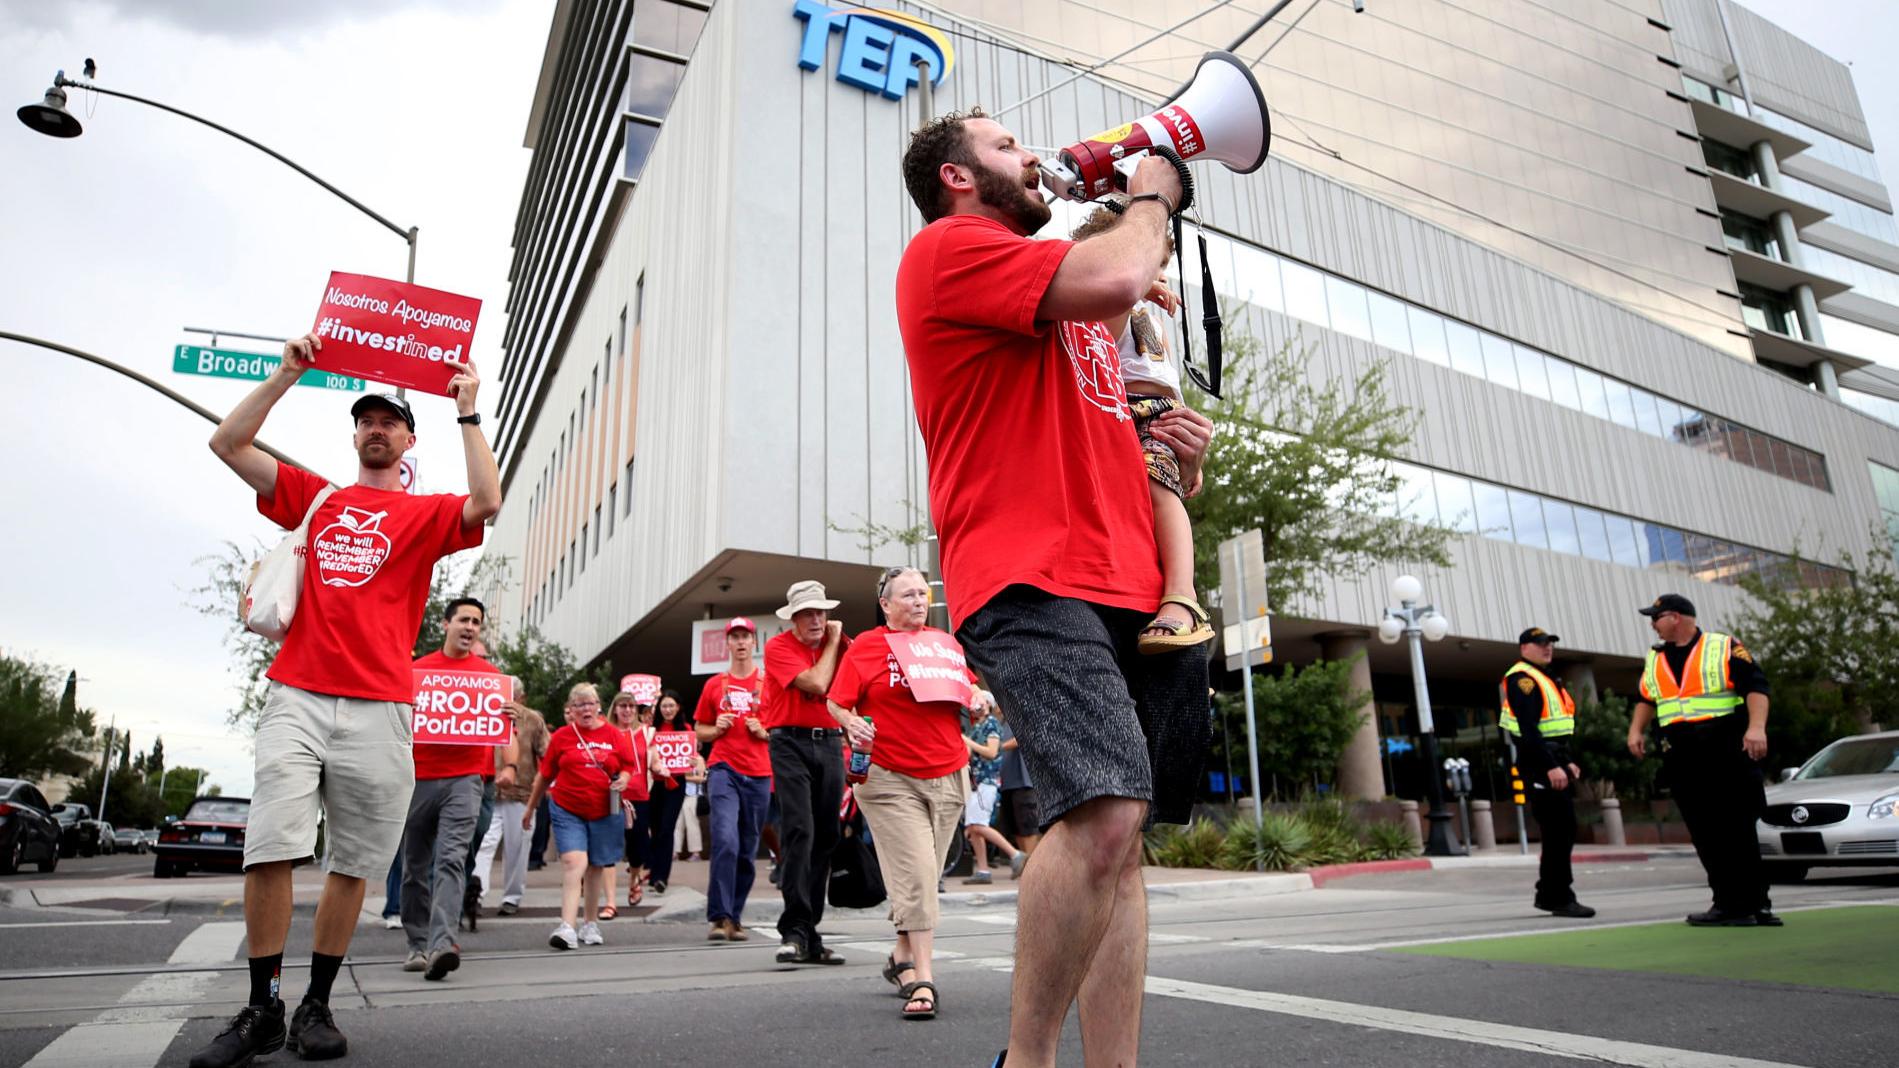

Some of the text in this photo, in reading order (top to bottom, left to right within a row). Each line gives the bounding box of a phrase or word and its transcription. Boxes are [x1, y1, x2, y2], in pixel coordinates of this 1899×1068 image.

[793, 0, 945, 101] TEP
[325, 287, 472, 333] Nosotros Apoyamos
[317, 317, 463, 363] #investined
[180, 347, 279, 376] E Broadw
[326, 376, 347, 389] 100
[353, 378, 361, 390] S
[316, 540, 375, 556] REMEMBER
[375, 548, 385, 556] in
[335, 533, 374, 548] we will
[316, 550, 381, 566] NOVEMBER
[421, 674, 501, 690] APOYAMOS
[413, 713, 505, 737] PorLaED
